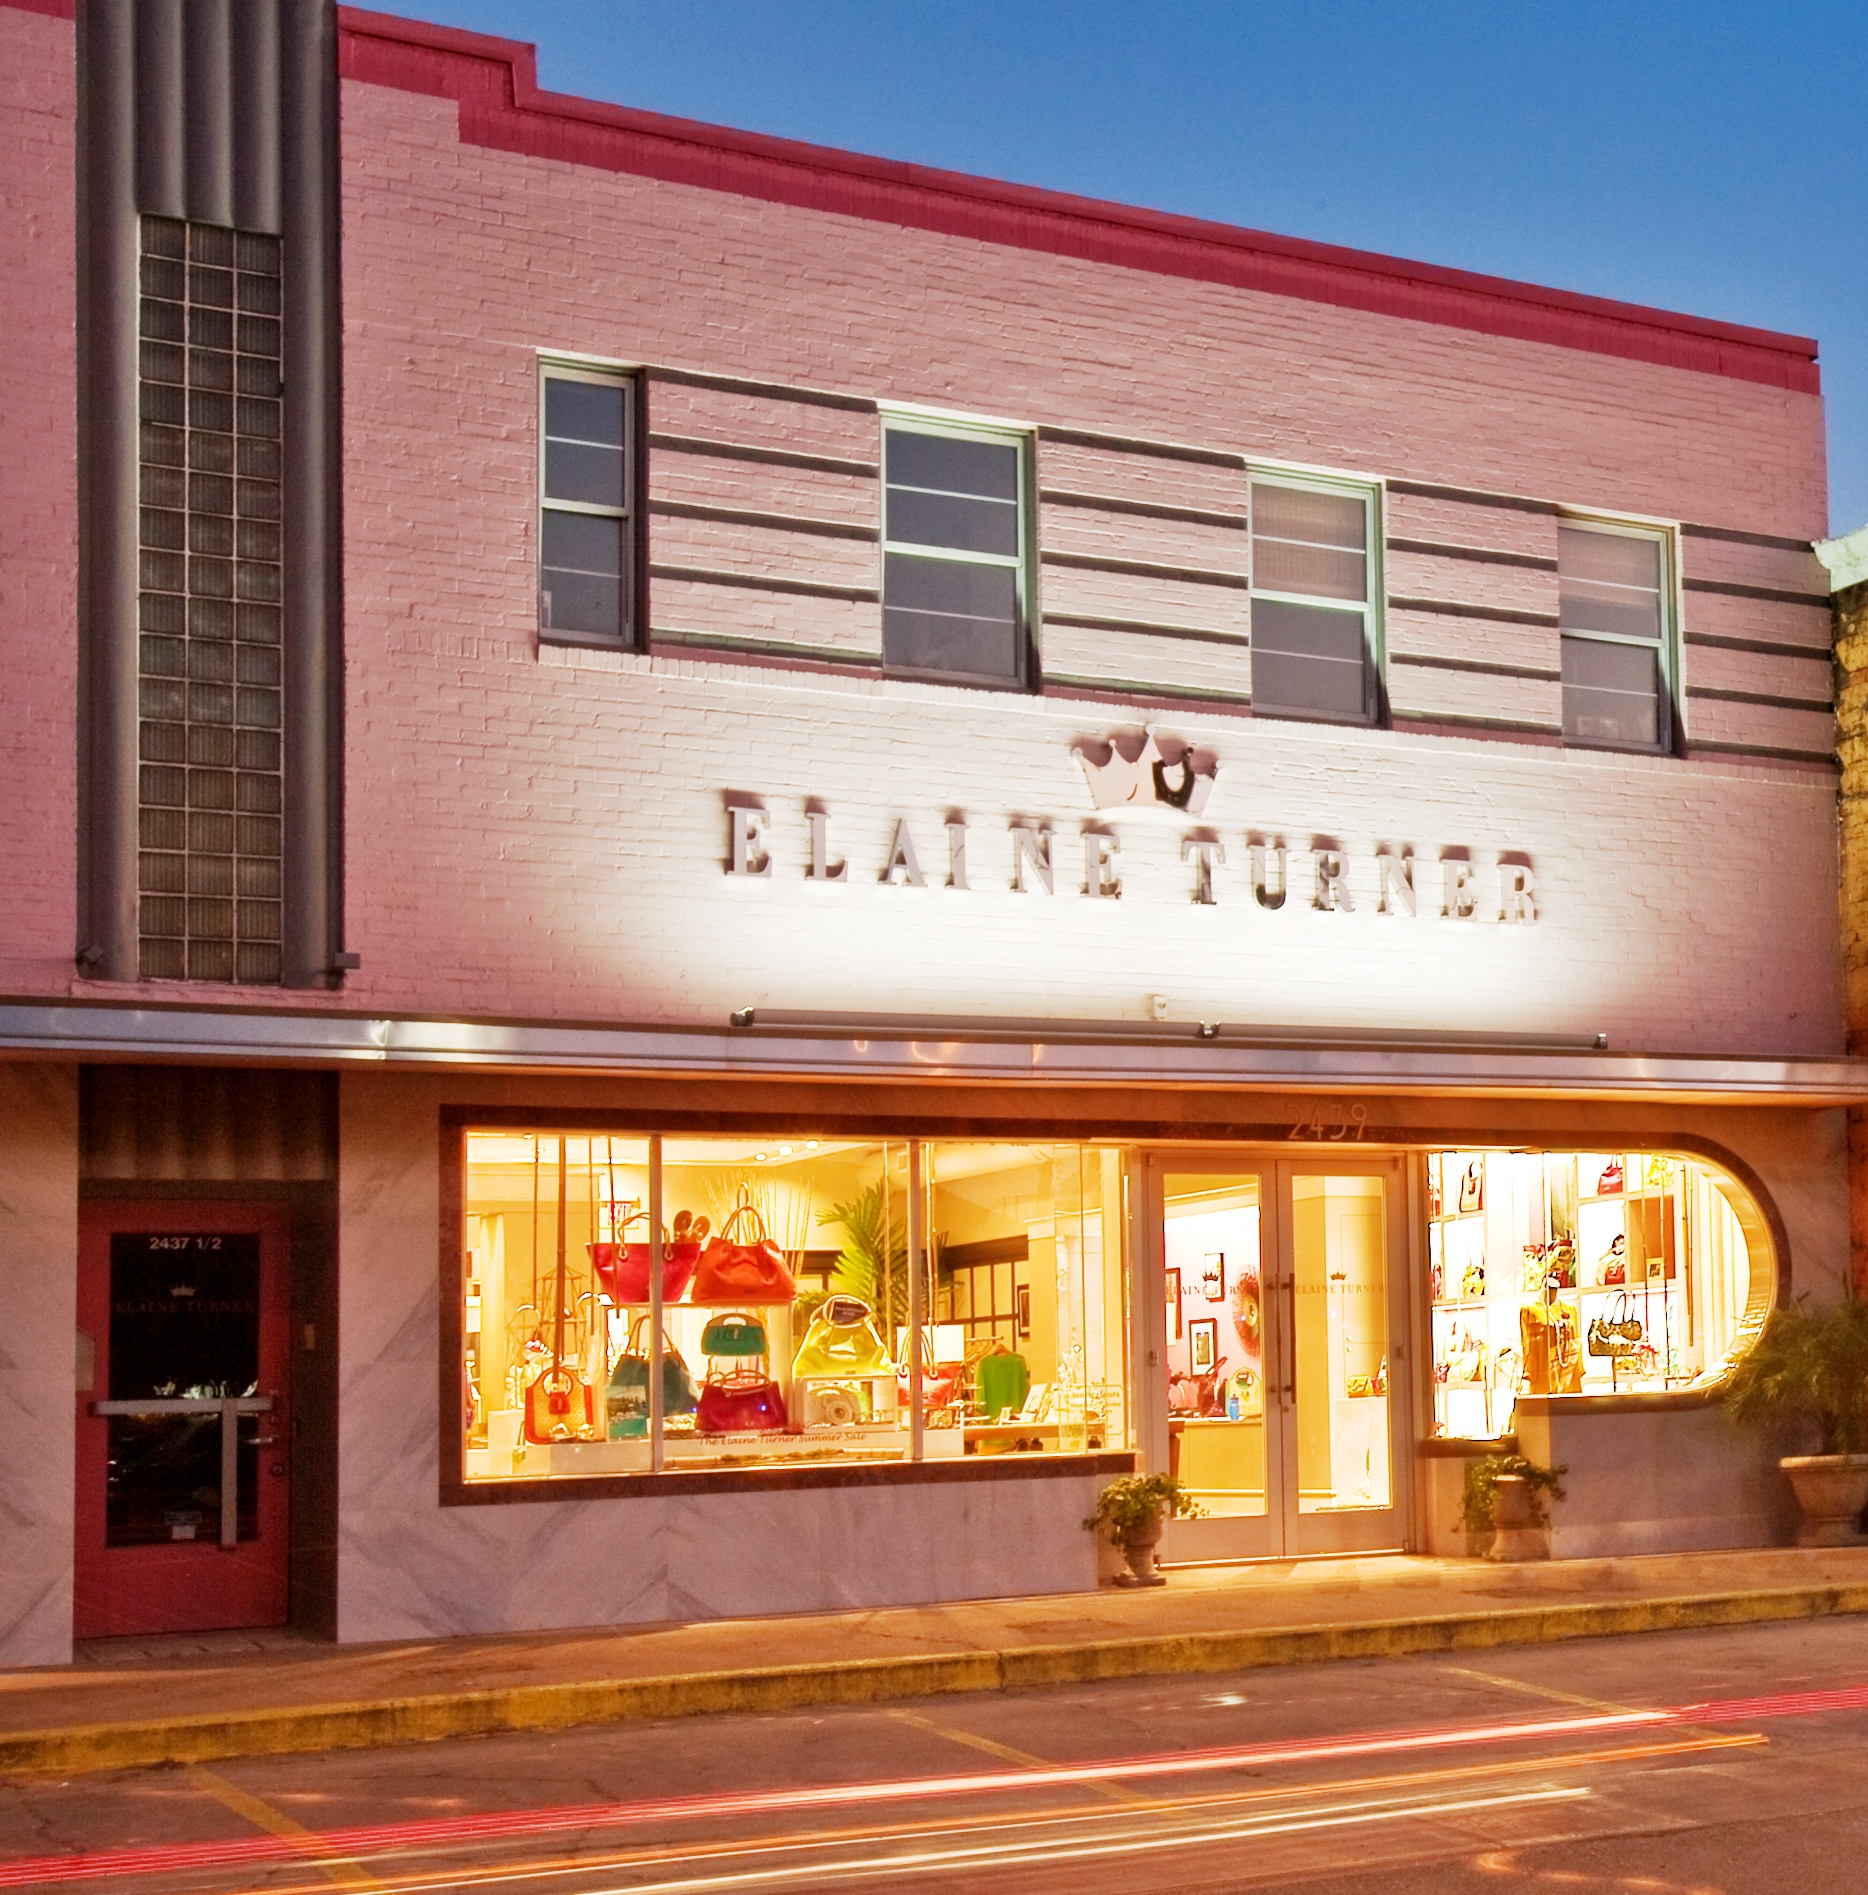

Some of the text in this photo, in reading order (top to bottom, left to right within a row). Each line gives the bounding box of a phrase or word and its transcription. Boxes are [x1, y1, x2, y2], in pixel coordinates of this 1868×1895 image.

[726, 806, 1538, 925] ELAINE TURNER
[1286, 1100, 1367, 1140] 2439
[150, 1237, 222, 1250] 2437 1/2
[1295, 1284, 1385, 1294] ELAINE TURNER
[115, 1301, 254, 1313] ELAINE TURNER
[700, 1431, 866, 1446] The Elaine Turner Summer Sale
